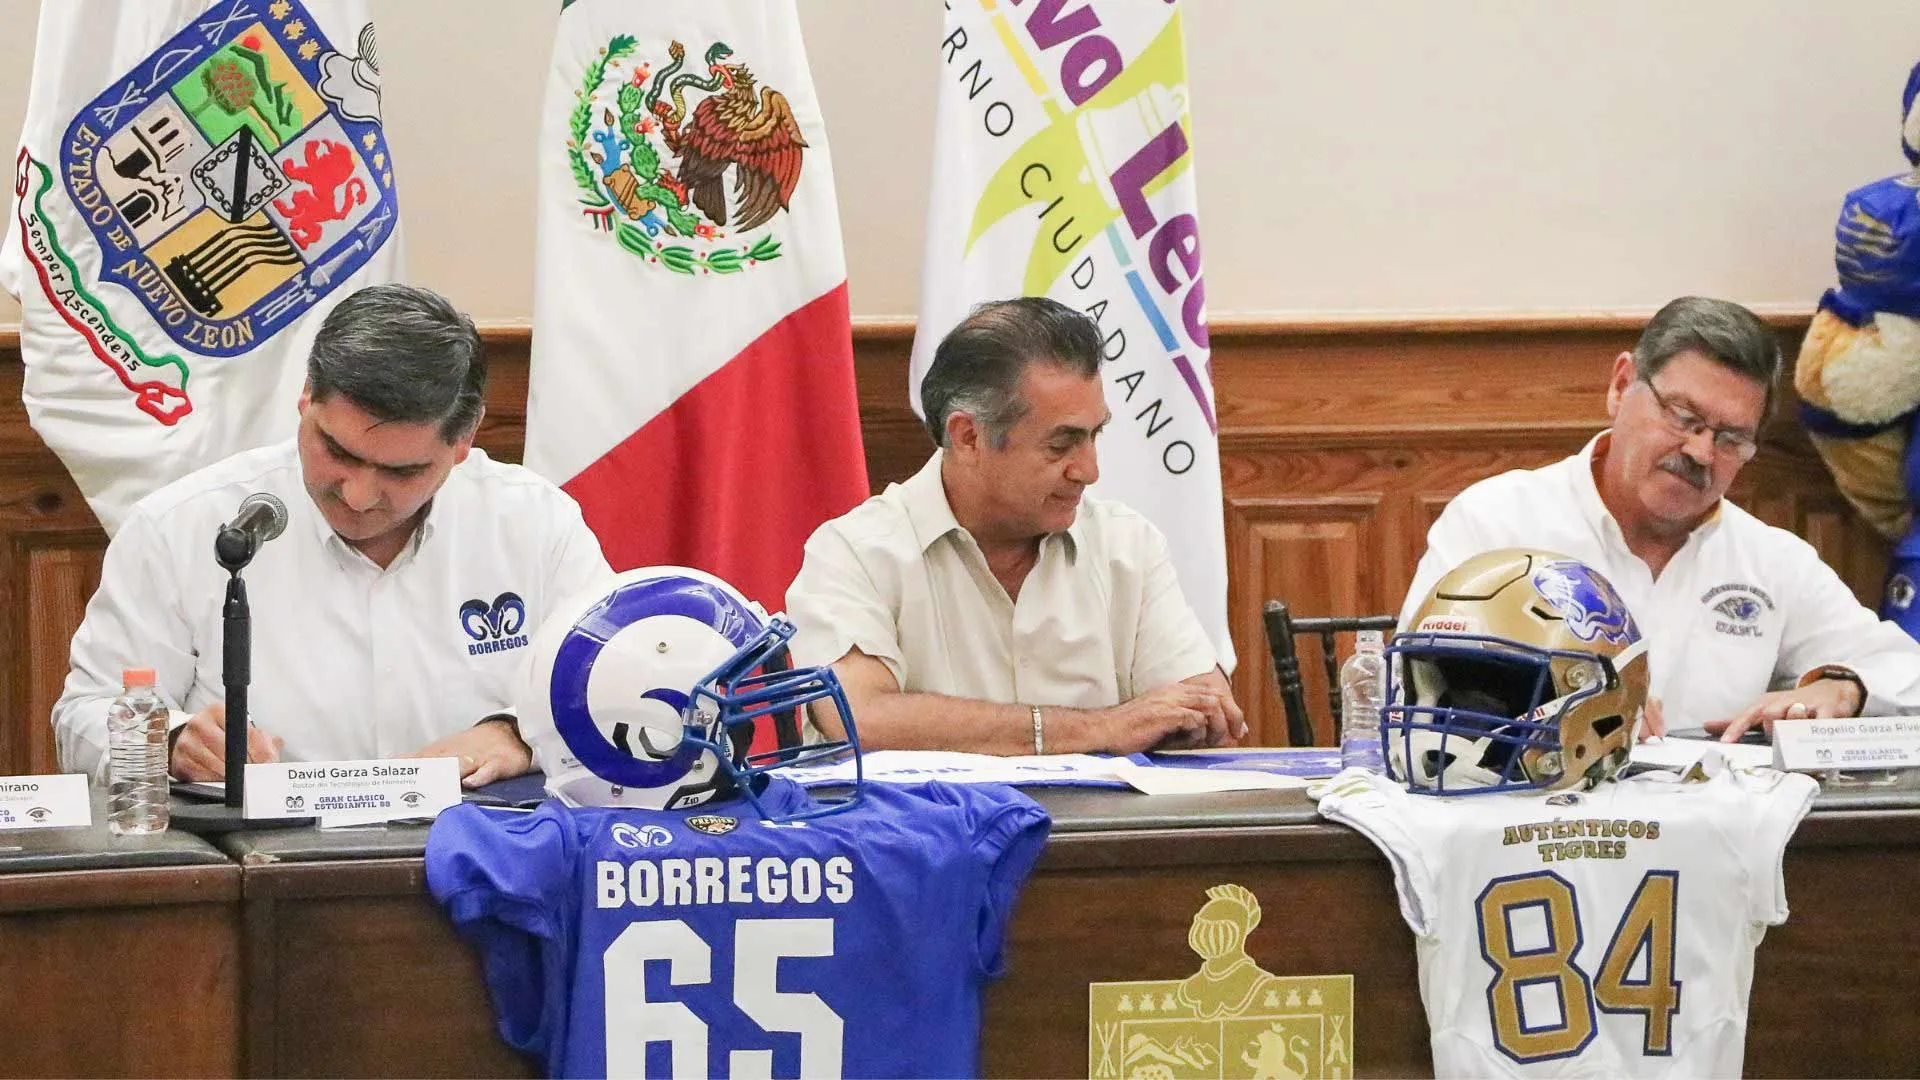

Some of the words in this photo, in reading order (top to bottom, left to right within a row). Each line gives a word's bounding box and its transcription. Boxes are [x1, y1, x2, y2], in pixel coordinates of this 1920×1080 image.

[1009, 0, 1124, 107] vo
[69, 123, 113, 226] ESTADO
[107, 225, 133, 252] DE
[942, 0, 1013, 136] RNO
[1021, 163, 1195, 474] CIUDADANO
[26, 213, 64, 283] Semper
[56, 289, 141, 371] Ascendens
[112, 259, 187, 326] NUEVO
[468, 635, 529, 656] BORREGOS
[1811, 726, 1856, 736] Rogelio
[1859, 723, 1892, 733] Garza
[288, 768, 325, 779] David
[330, 767, 368, 778] Garza
[372, 766, 420, 777] Salazar
[314, 801, 377, 810] ESTUDIANTIL
[1503, 817, 1660, 845] AUTÉNTICOS
[1538, 840, 1627, 862] TIGRES
[596, 856, 854, 909] BORREGOS
[1474, 869, 1683, 1065] 84
[603, 918, 845, 1080] 65
